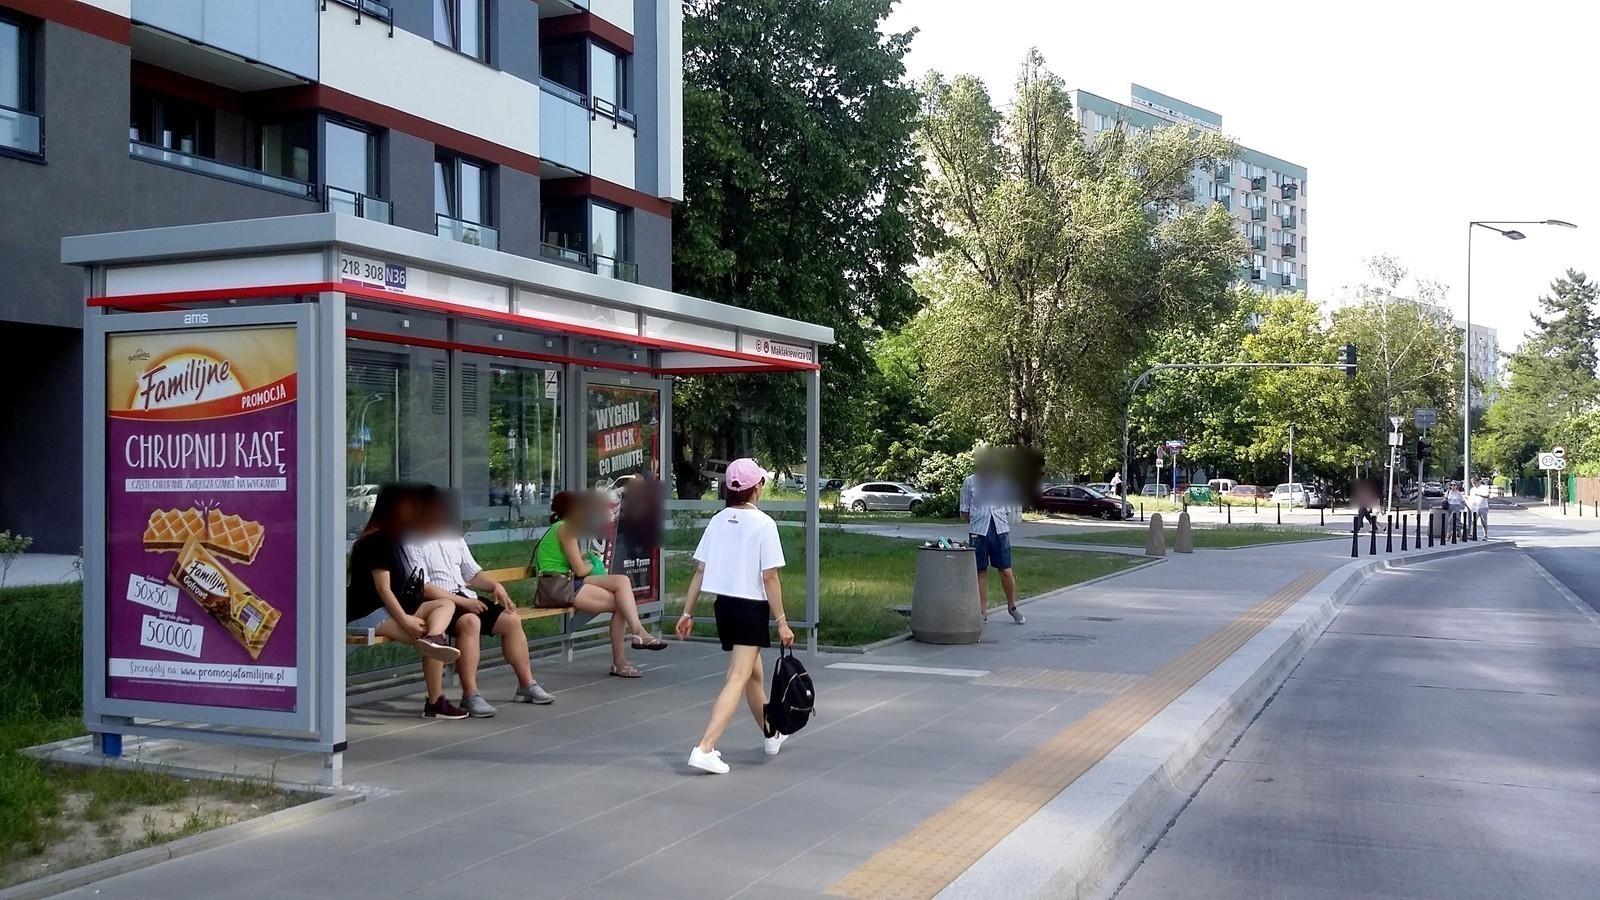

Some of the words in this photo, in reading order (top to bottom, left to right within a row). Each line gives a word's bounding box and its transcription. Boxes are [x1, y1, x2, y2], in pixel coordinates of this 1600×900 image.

[342, 259, 360, 276] 218
[364, 263, 384, 281] 308
[386, 267, 406, 285] N36
[184, 313, 209, 324] ams
[806, 351, 812, 361] 02
[141, 358, 230, 409] Familijne
[241, 384, 287, 409] PROMOCJA
[596, 401, 640, 430] WYGRAJ
[125, 432, 226, 469] CHRUPNIJ
[235, 431, 286, 474] KASĘ
[604, 428, 635, 452] BLACK
[600, 458, 611, 476] CO
[183, 575, 208, 600] Gofrowe
[190, 560, 230, 593] Familijne
[134, 581, 169, 606] 50x50
[147, 620, 193, 650] 50000
[130, 661, 165, 677] Szczegóły
[180, 667, 285, 684] www.promocjafamilijne.pl
